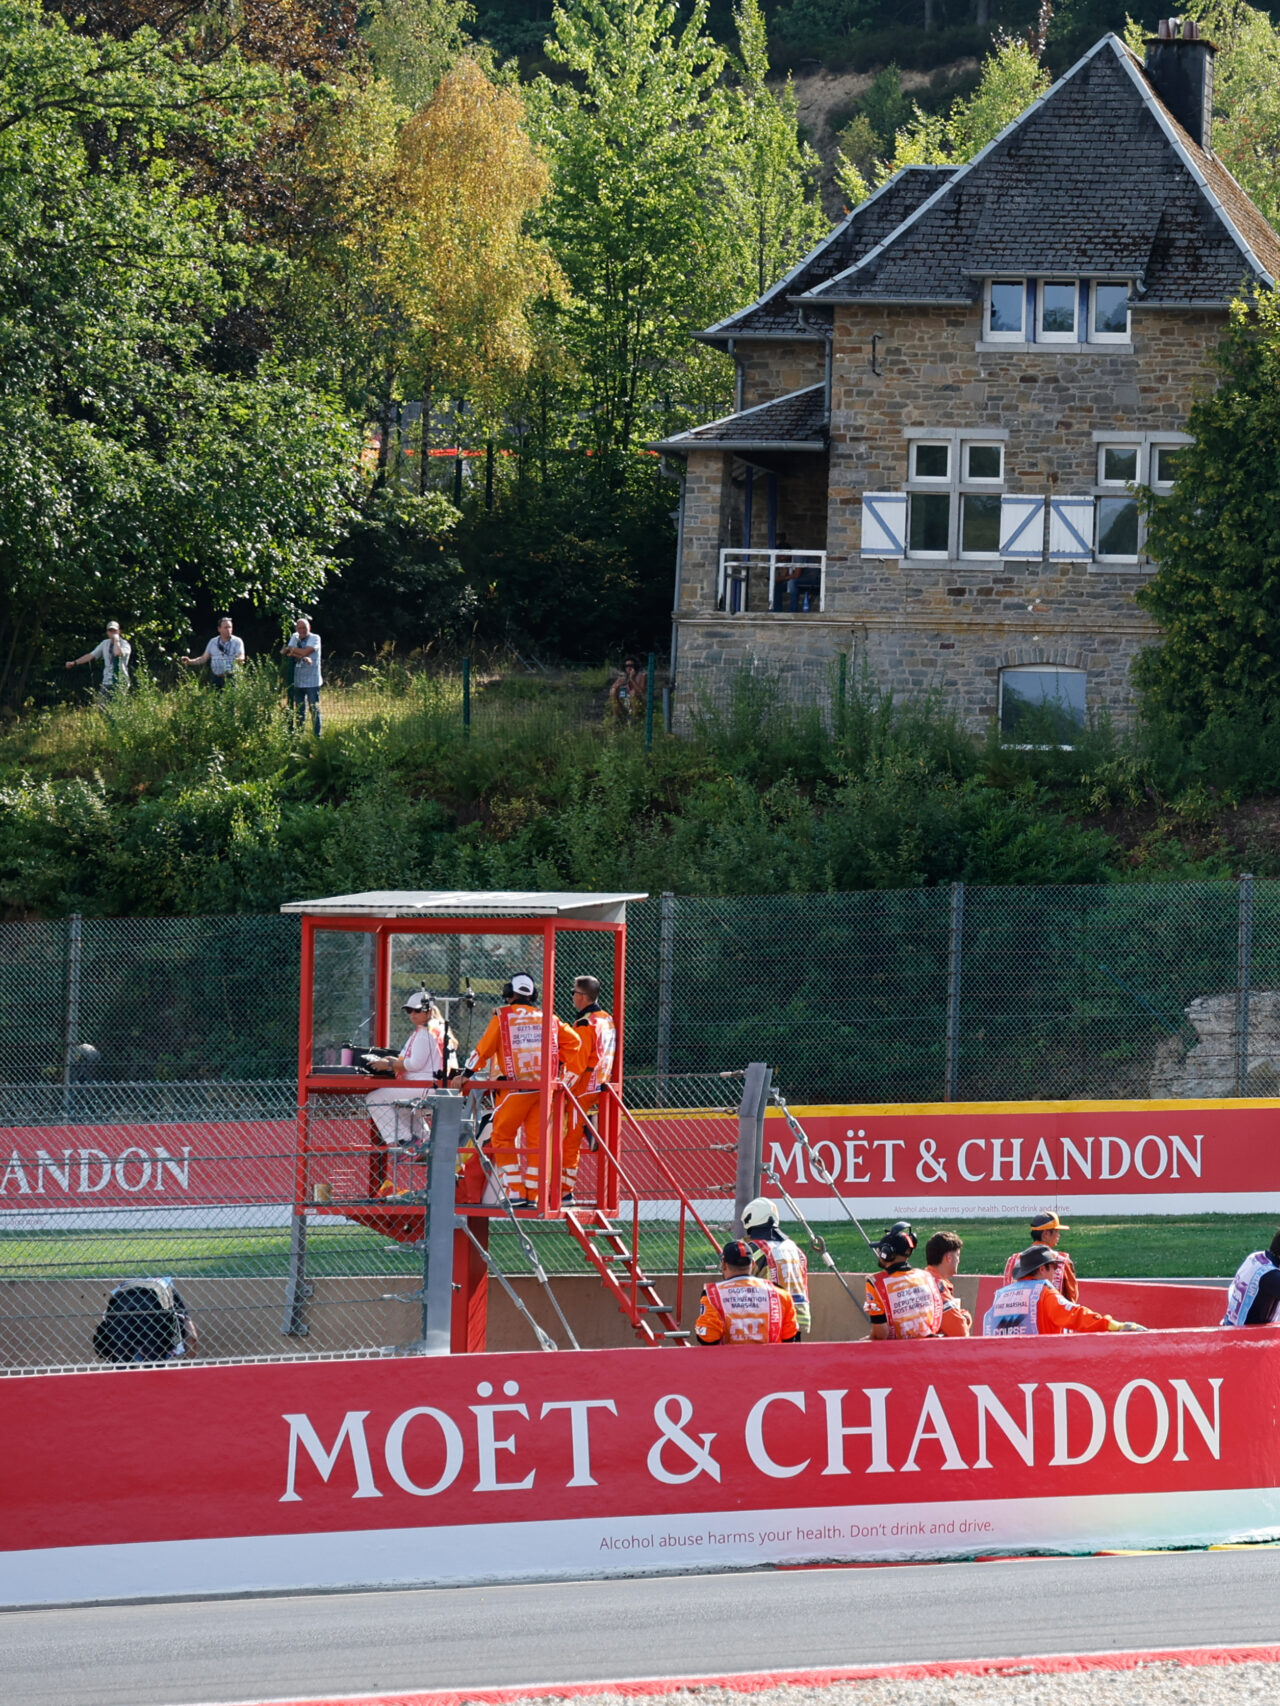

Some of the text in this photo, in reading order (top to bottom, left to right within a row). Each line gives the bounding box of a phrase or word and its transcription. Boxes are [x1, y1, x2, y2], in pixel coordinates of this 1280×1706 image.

[0, 1147, 193, 1194] ANDON
[767, 1130, 1204, 1184] MOËT & CHANDON
[894, 1205, 918, 1213] Alcohol
[918, 1205, 938, 1213] abuse
[939, 1204, 960, 1213] harms
[961, 1206, 976, 1215] your
[1020, 1203, 1038, 1212] drink
[279, 1377, 1224, 1501] MOËT & CHANDON
[599, 1518, 995, 1551] Alcohol abuse harms your health. Don't drink and drive.
